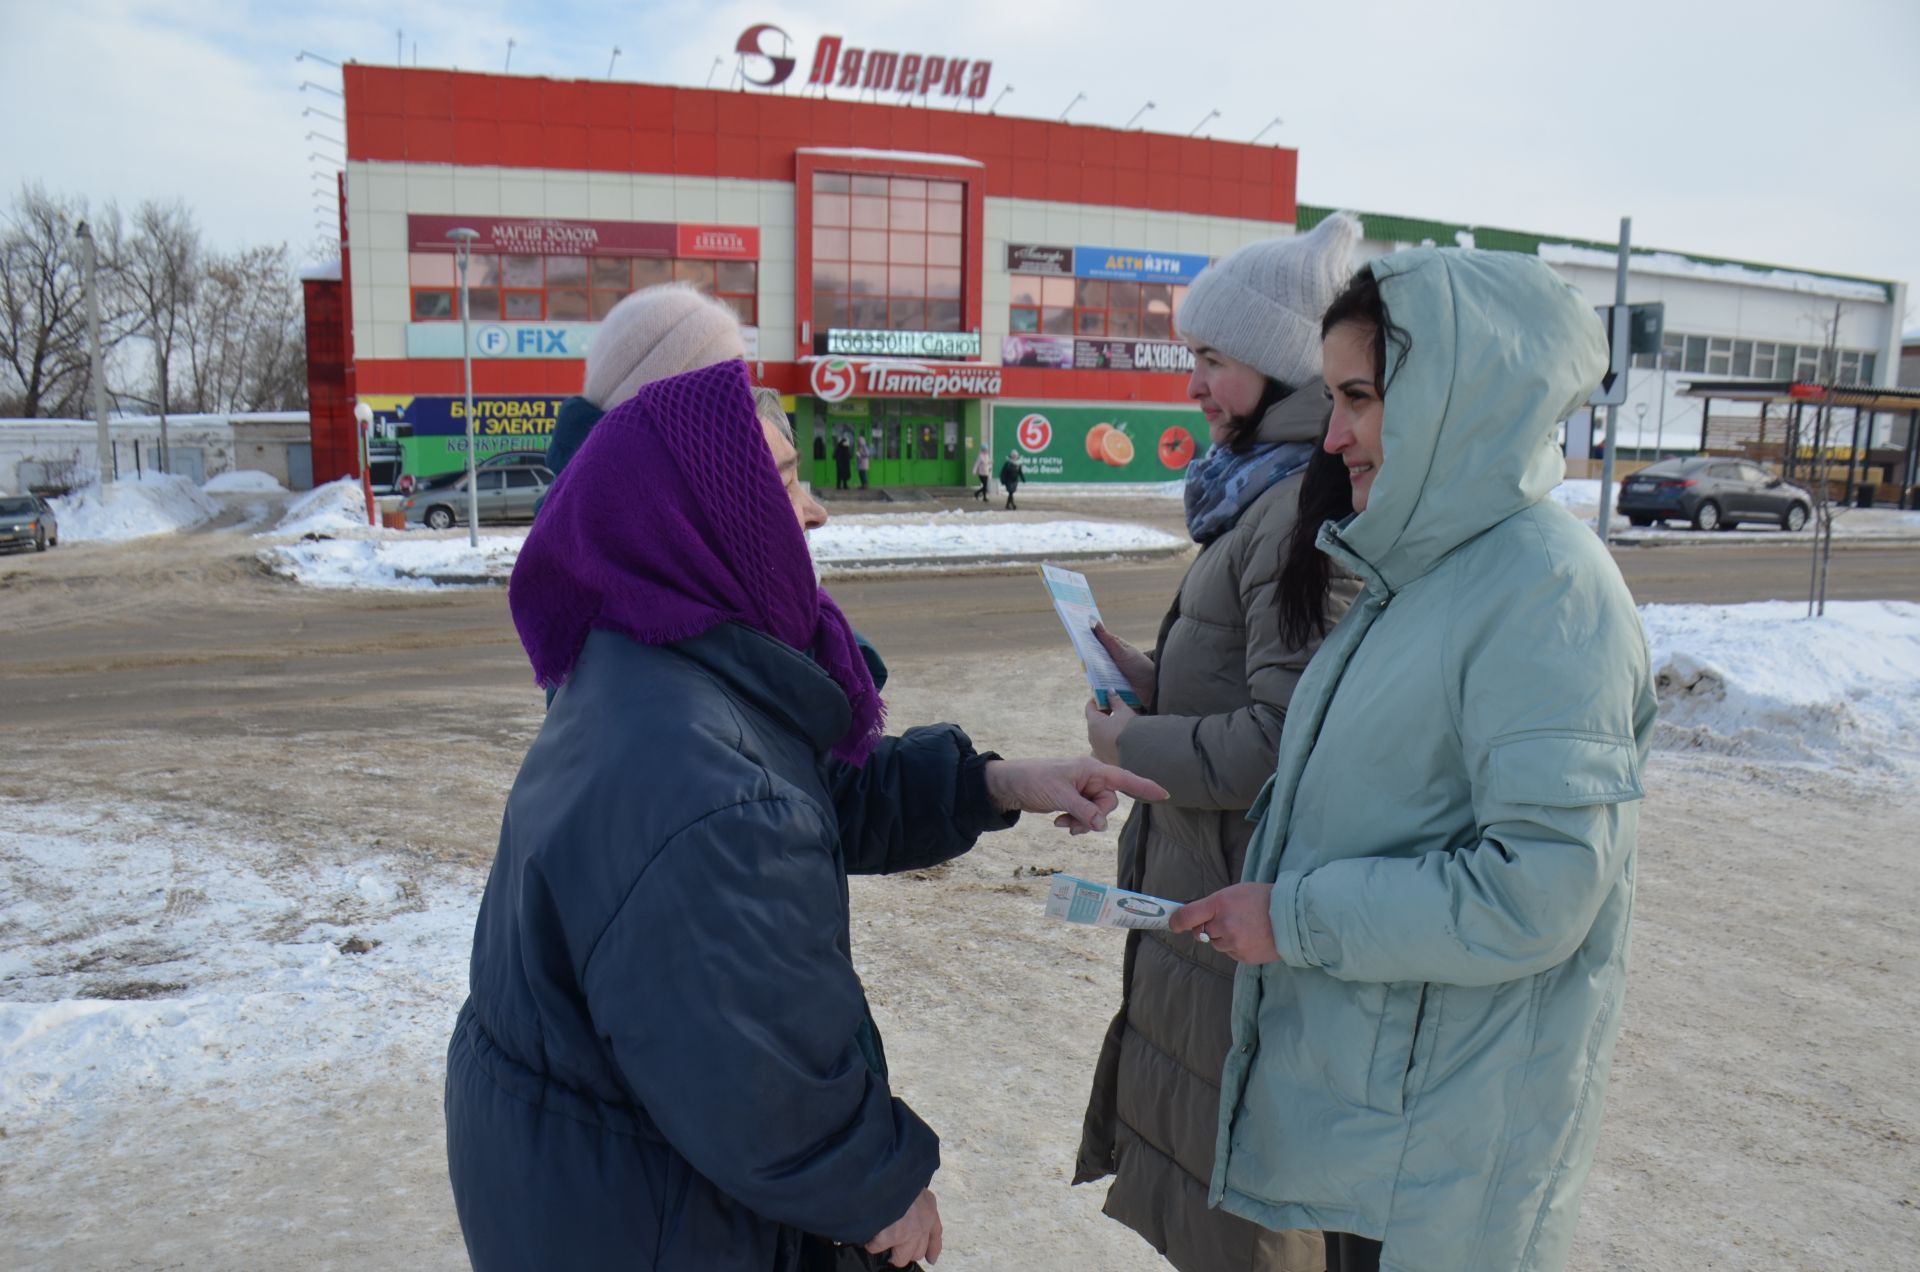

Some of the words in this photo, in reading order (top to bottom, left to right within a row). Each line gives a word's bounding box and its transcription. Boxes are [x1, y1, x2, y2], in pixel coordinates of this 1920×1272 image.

[809, 34, 992, 100] Пятерка
[491, 225, 542, 240] МАГИЯ
[546, 227, 599, 242] ЗОЛОТА
[450, 401, 546, 418] БЫТОВАЯ
